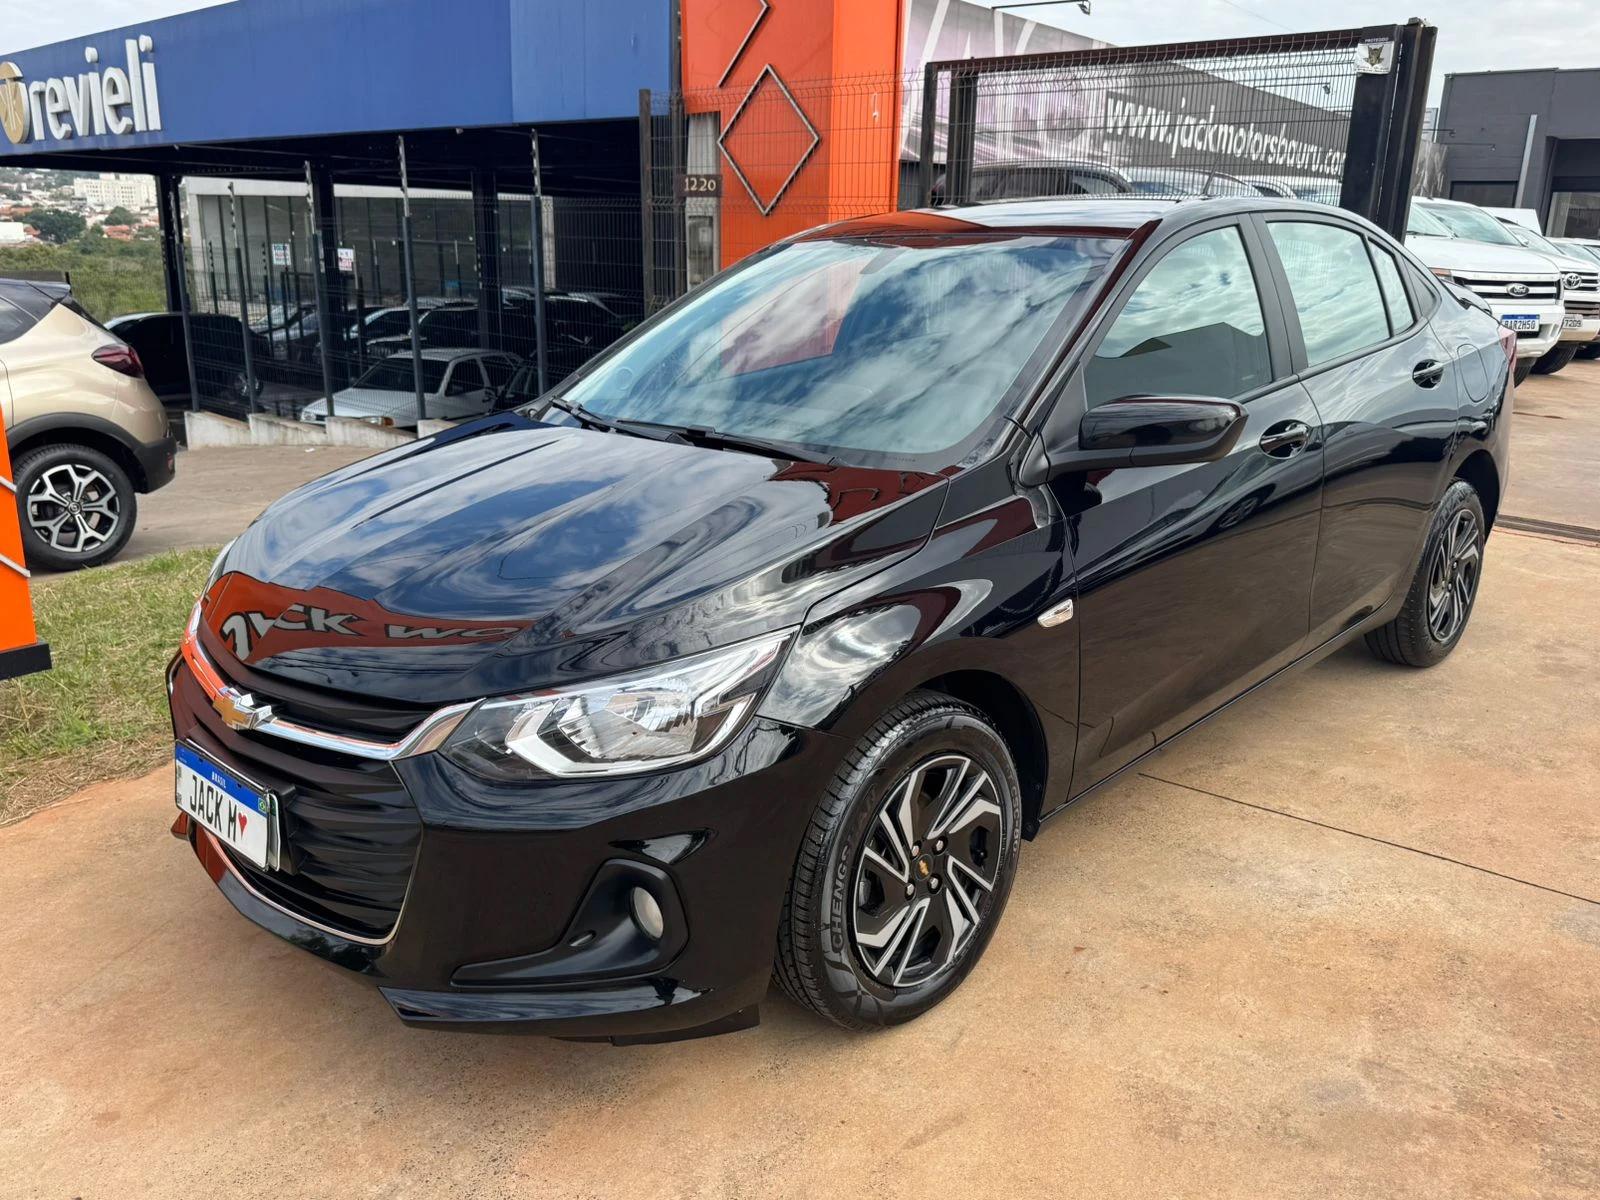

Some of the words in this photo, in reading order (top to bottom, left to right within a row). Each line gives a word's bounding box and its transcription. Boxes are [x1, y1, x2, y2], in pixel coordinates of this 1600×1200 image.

[684, 177, 717, 192] 1220
[190, 774, 223, 833] JACK
[227, 799, 238, 843] M
